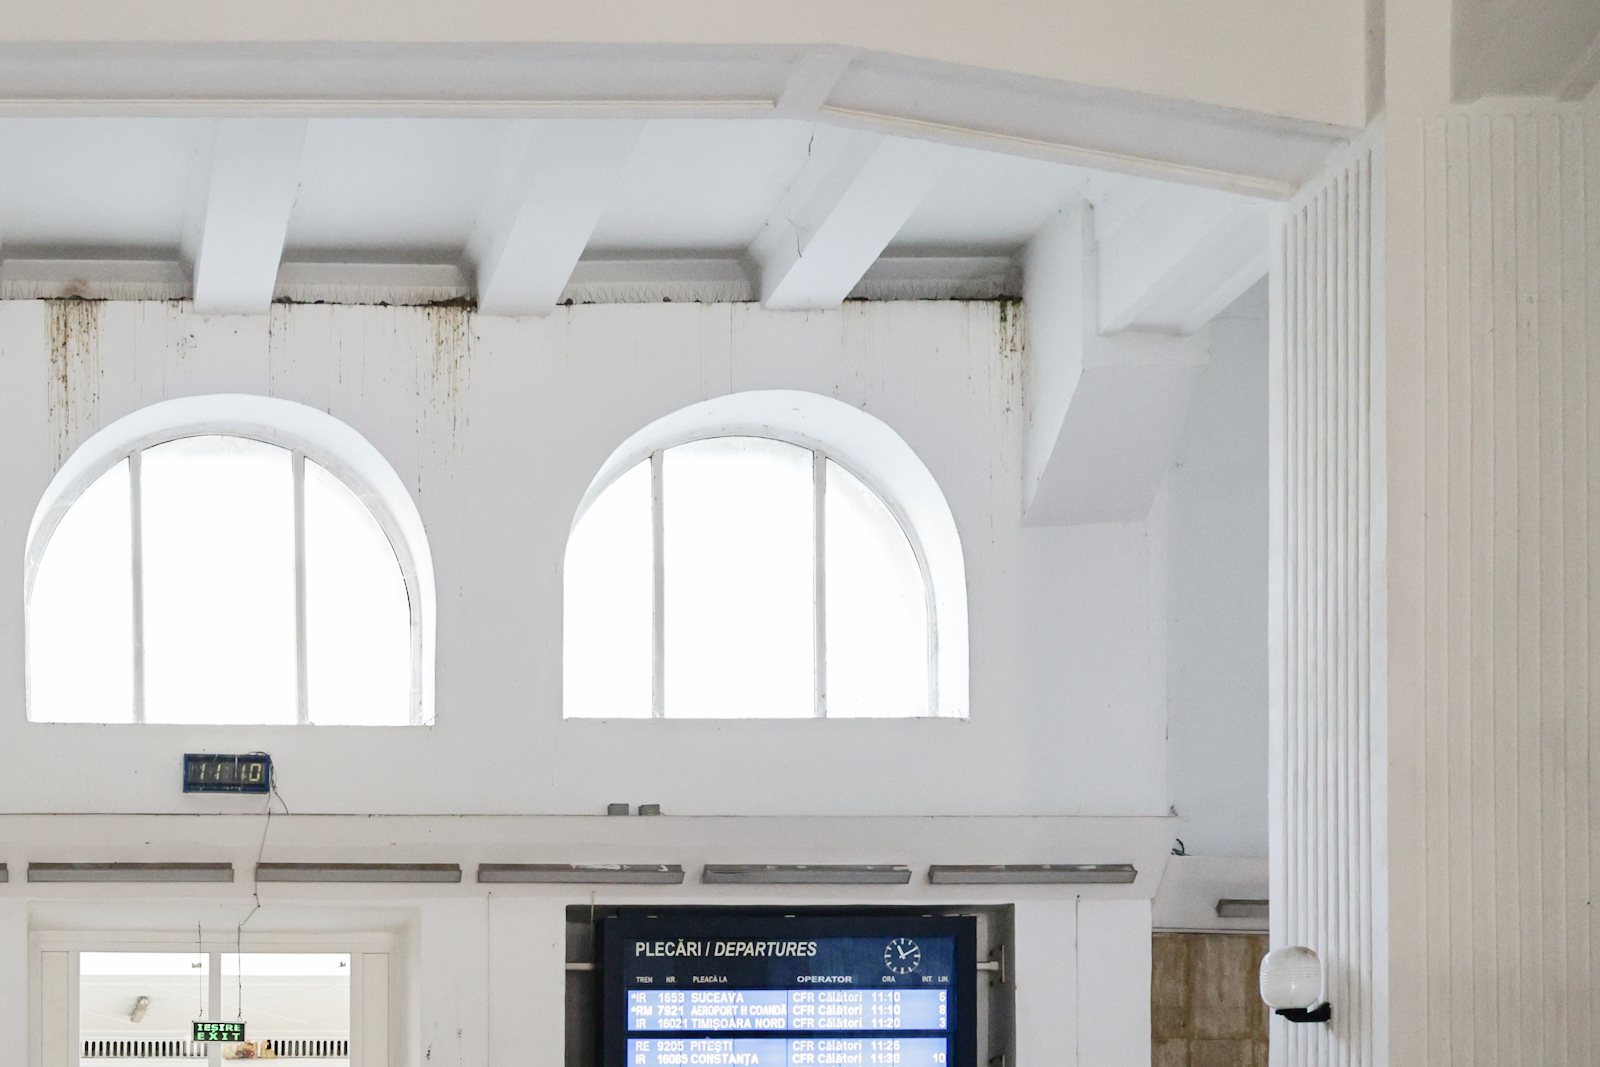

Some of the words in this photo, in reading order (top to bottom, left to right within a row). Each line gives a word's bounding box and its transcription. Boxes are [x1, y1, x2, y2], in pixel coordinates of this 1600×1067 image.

[636, 938, 701, 956] PLECĂRI
[705, 942, 710, 956] /
[714, 942, 817, 956] DEPARTURES
[657, 993, 684, 1003] 1653
[691, 993, 744, 1003] SUCEAVA
[793, 992, 814, 1002] CFR
[818, 992, 862, 1002] Călători
[871, 992, 900, 1002] 11:10
[939, 992, 946, 1002] 6
[657, 1005, 683, 1016] 7921
[691, 1005, 738, 1016] AEROPORT
[741, 1005, 747, 1016] H
[750, 1004, 787, 1016] COANDĂ
[793, 1004, 814, 1015] CFR
[818, 1004, 862, 1015] Călători
[871, 1004, 900, 1015] 11:10
[939, 1004, 946, 1015] 8
[636, 1018, 646, 1028] IR
[657, 1018, 687, 1028] 16021
[692, 1018, 751, 1030] TIMIȘOARA
[755, 1018, 786, 1028] NORD
[793, 1018, 814, 1028] CFR
[818, 1018, 862, 1028] Călători
[871, 1018, 900, 1028] 11:20
[939, 1018, 946, 1028] 3
[197, 1032, 240, 1040] EXIT
[636, 1041, 649, 1051] RE
[657, 1041, 684, 1051] 9205
[691, 1041, 732, 1052] PITEȘTI
[793, 1040, 814, 1051] CFR
[818, 1040, 862, 1051] Călători
[871, 1040, 900, 1051] 11:26
[636, 1054, 646, 1064] IR
[657, 1054, 688, 1064] 16085
[690, 1054, 759, 1066] CONSTANȚA
[793, 1053, 814, 1063] CFR
[818, 1053, 862, 1063] Călători
[871, 1053, 900, 1063] 11:30
[933, 1053, 946, 1063] 10
